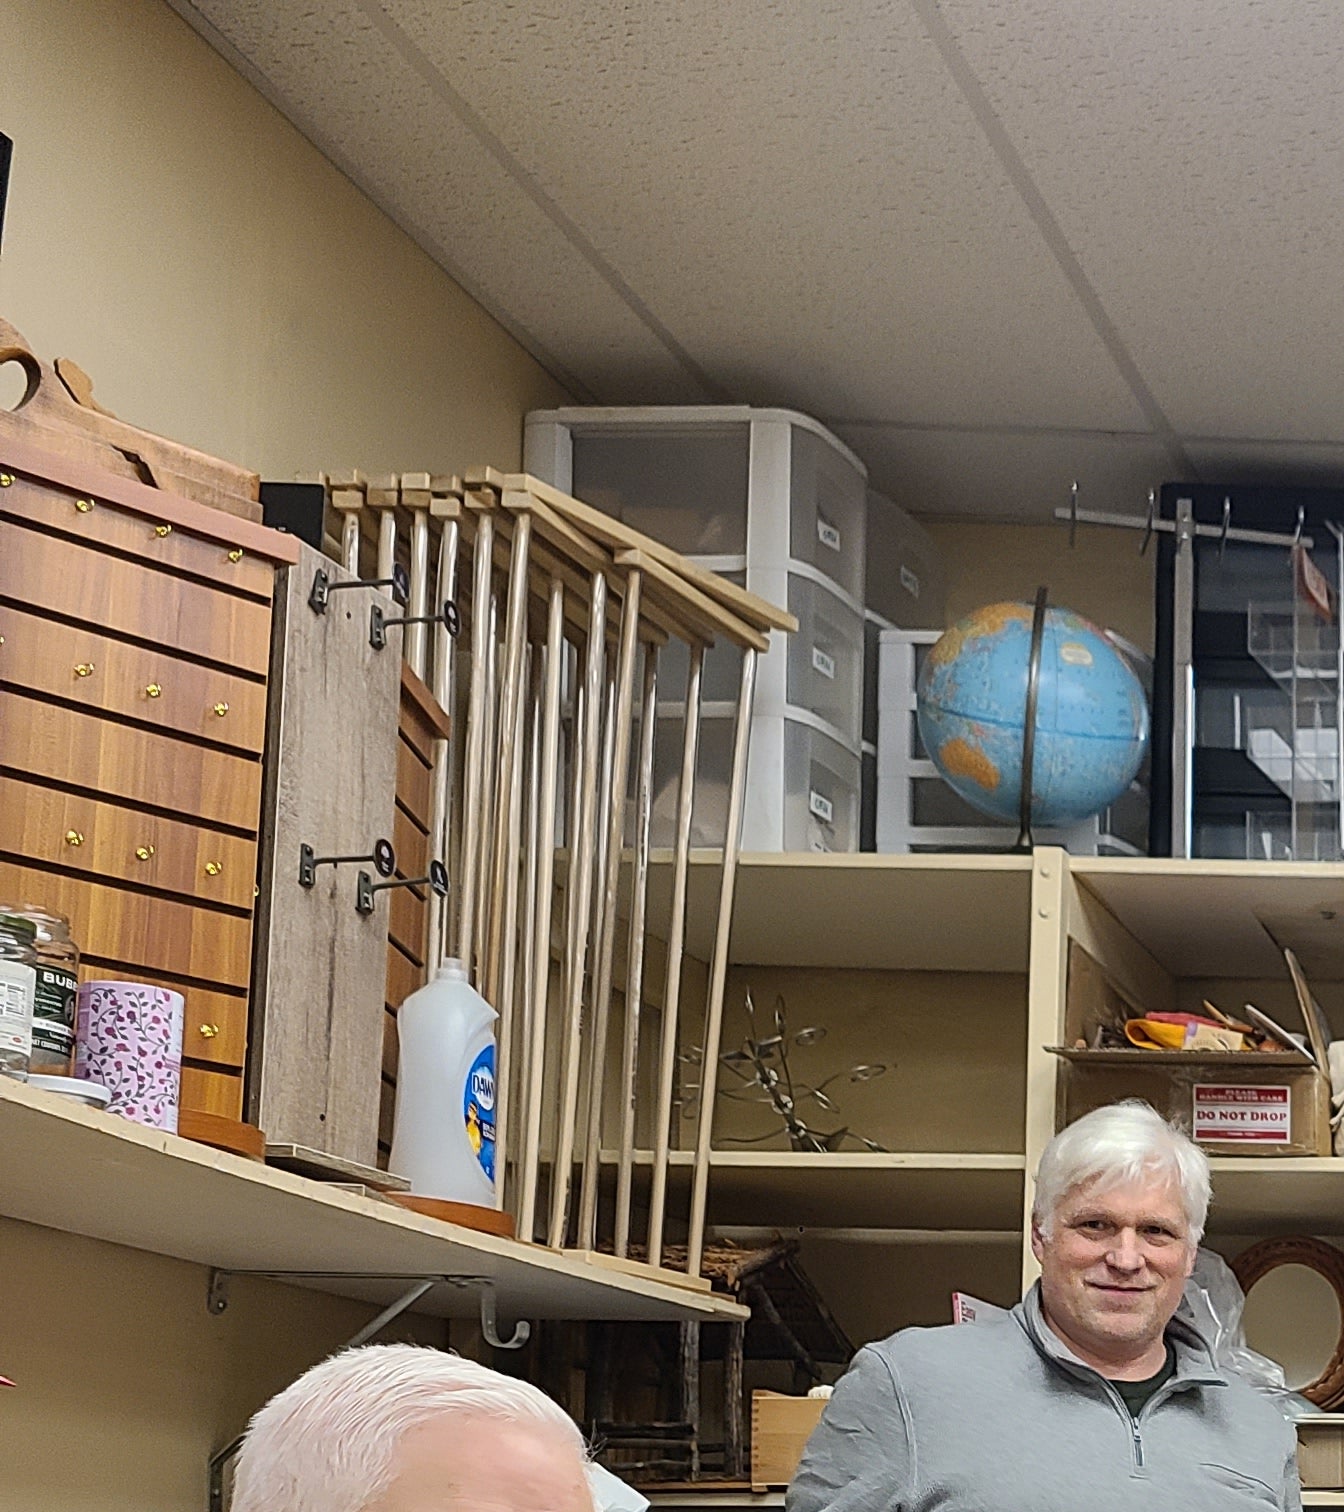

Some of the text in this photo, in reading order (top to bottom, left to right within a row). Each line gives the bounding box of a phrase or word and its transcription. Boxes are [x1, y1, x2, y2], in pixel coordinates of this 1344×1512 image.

[1196, 1110, 1287, 1121] DO NOT DROP
